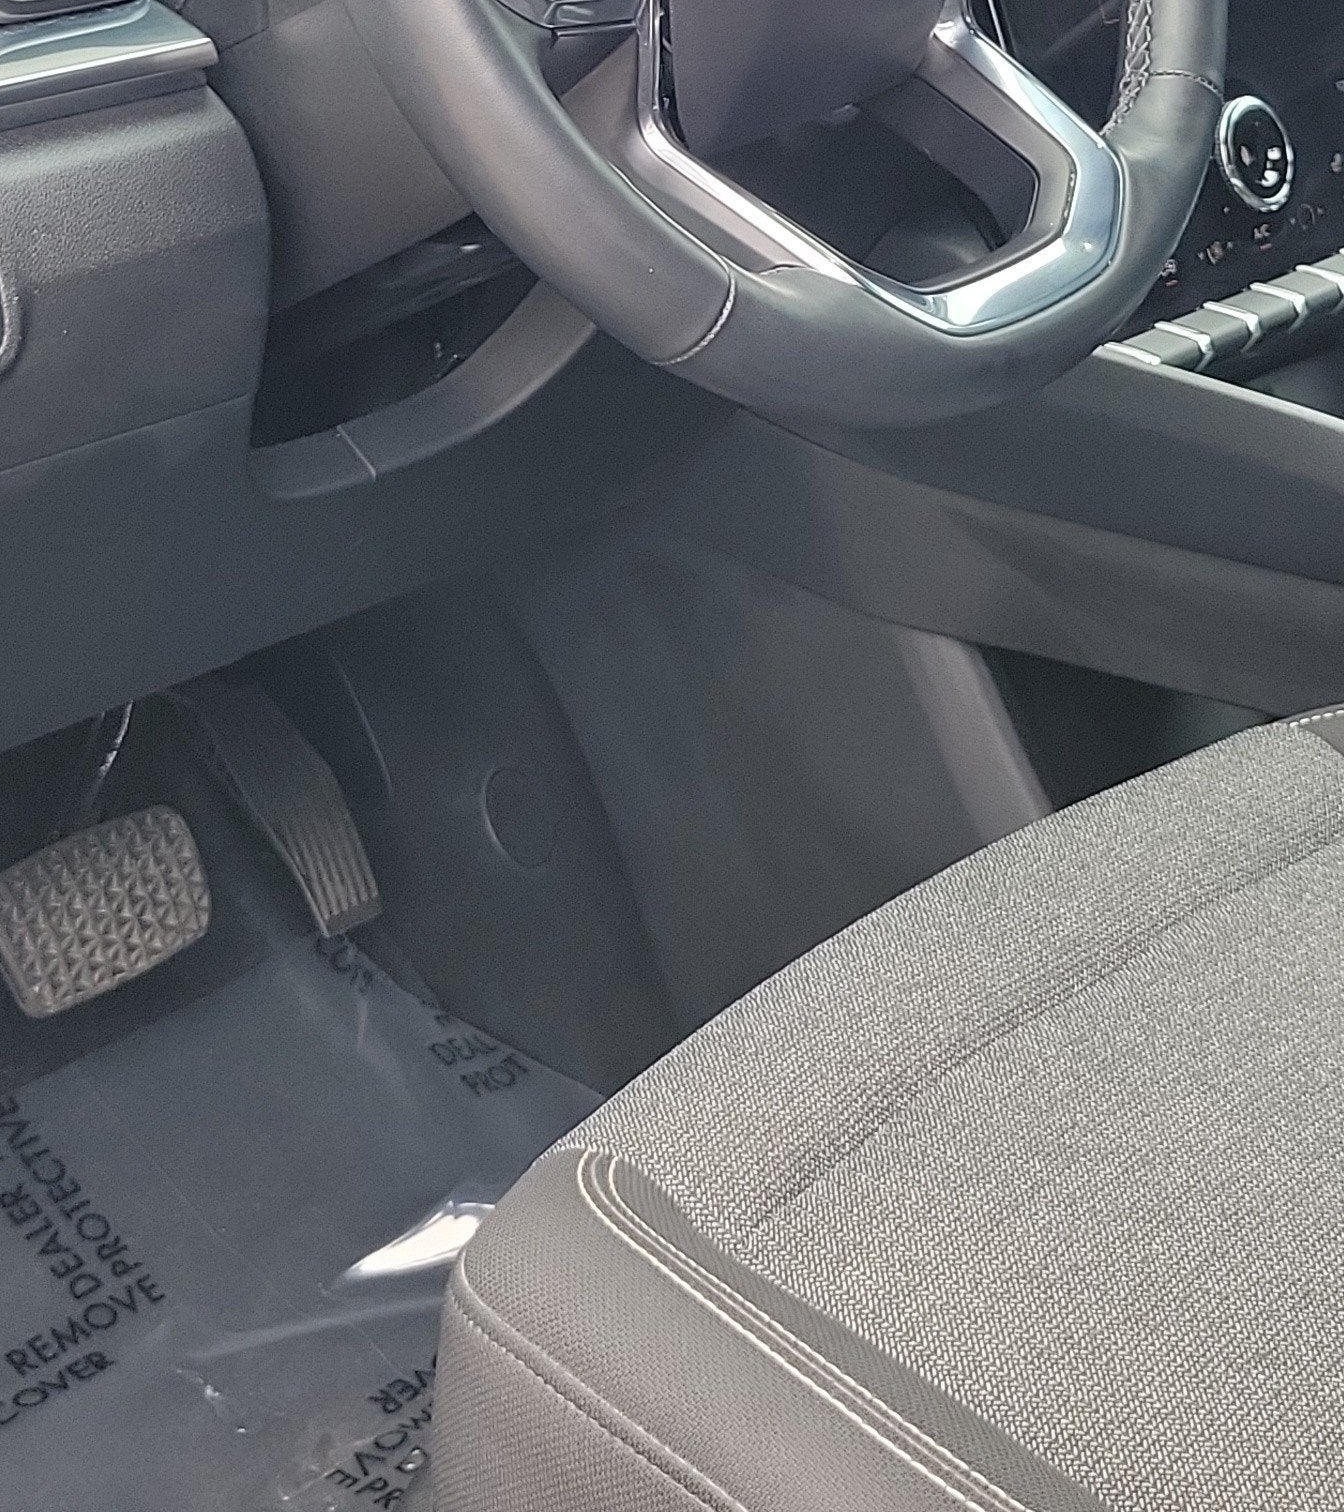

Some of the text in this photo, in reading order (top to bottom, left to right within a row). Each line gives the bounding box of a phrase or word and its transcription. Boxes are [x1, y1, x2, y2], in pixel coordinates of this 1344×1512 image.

[5, 1275, 166, 1376] REMOVE
[368, 1355, 437, 1414] VER
[324, 1400, 434, 1489] MOVE
